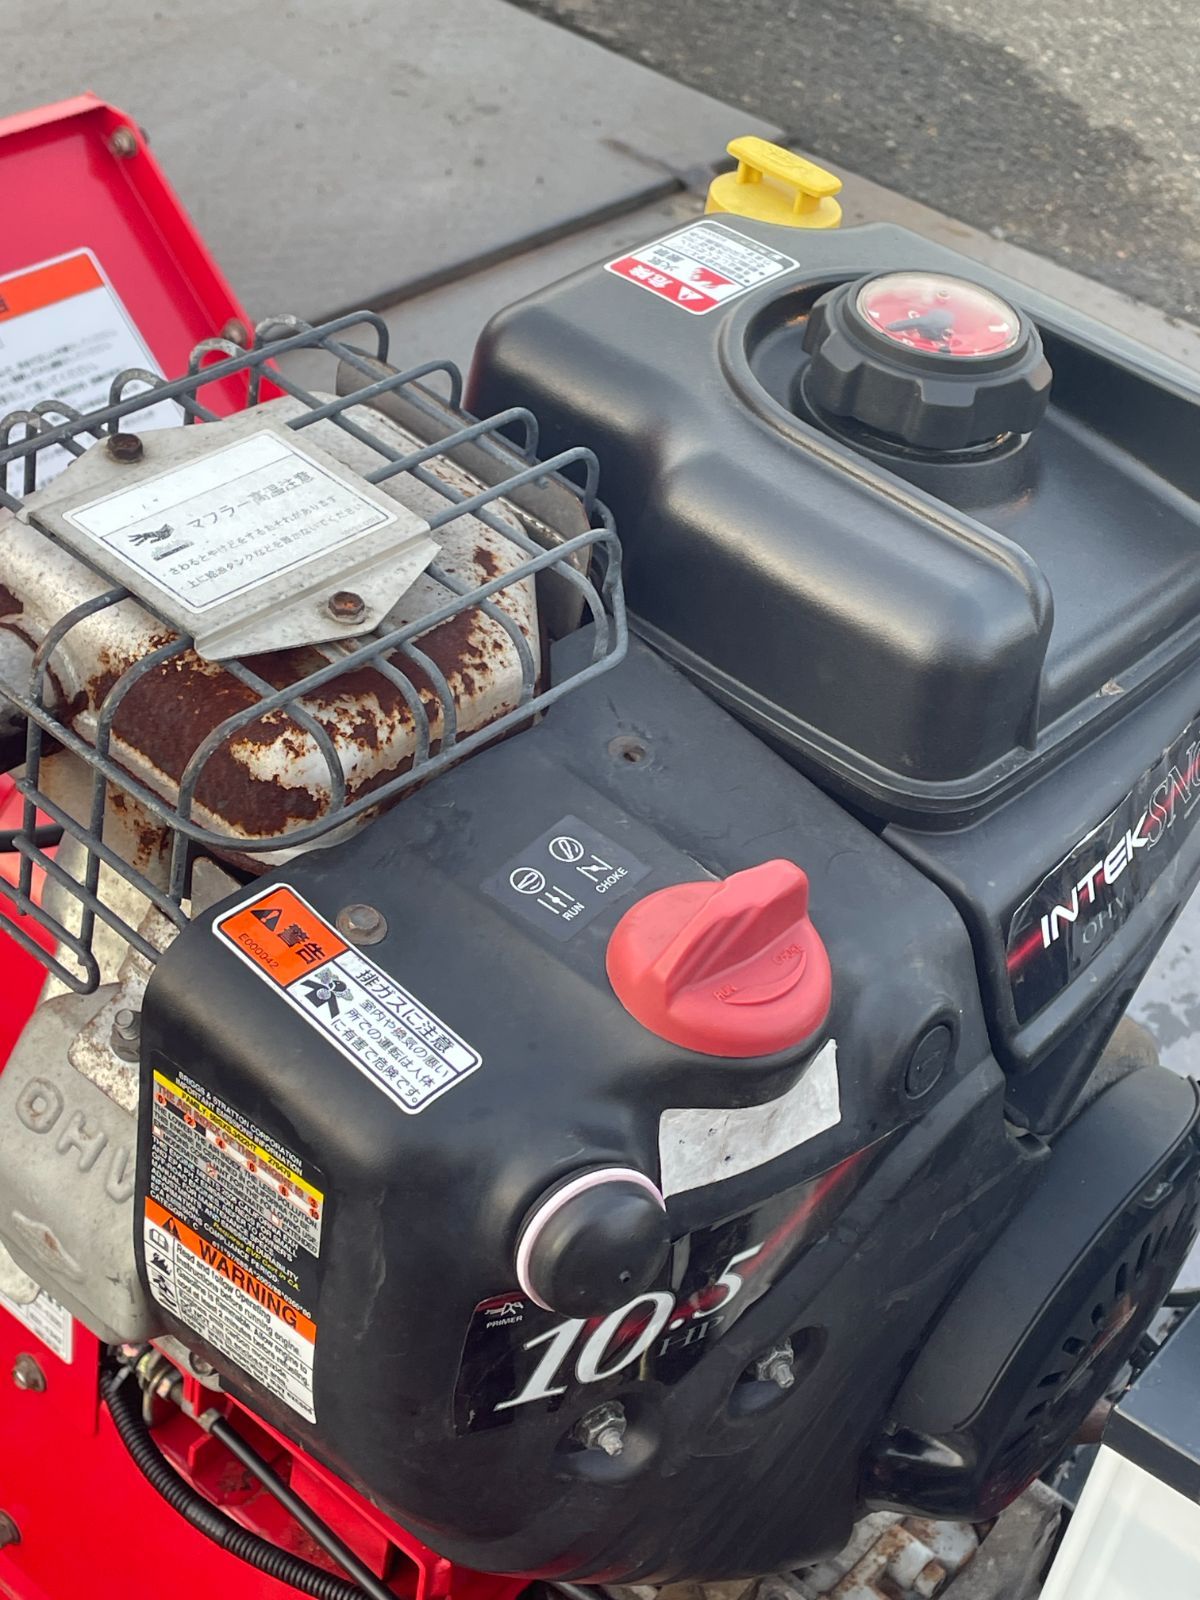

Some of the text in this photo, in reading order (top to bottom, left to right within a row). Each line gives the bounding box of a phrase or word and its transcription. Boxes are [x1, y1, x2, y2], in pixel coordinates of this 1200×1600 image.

[182, 469, 317, 532] マフラー高温注意
[561, 902, 585, 921] RUN
[595, 866, 629, 893] CHOKE
[1040, 811, 1148, 948] INTEK
[1082, 888, 1126, 944] OHV
[274, 921, 330, 967] 警告
[354, 967, 456, 1054] 排ガスに注意
[713, 983, 737, 1000] RUN
[328, 1017, 426, 1105] に有害で危険です。
[343, 1006, 437, 1090] 所での運転は人体
[358, 997, 451, 1079] 室内や換気の悪い
[15, 1078, 135, 1204] OHV
[154, 1102, 166, 1117] THE
[168, 1113, 192, 1136] LOWER
[193, 1131, 206, 1147] THE
[208, 1142, 219, 1157] AIR
[244, 1169, 257, 1184] THE
[258, 1180, 276, 1198] LESS
[175, 1077, 302, 1176] IMPORTANT EMISSIONS INFORMATION
[178, 1070, 301, 1167] BRIGGS & STRATTON CORPORATION
[151, 1158, 180, 1186] MANUAL
[181, 1181, 196, 1198] FOR
[197, 1193, 248, 1238] MAINTENANCE
[152, 1135, 167, 1152] THIS
[169, 1147, 195, 1173] ENGINE
[196, 1168, 220, 1192] MEETS
[238, 1200, 281, 1238] CALIFORNIA
[282, 1233, 298, 1251] EXH
[152, 1143, 167, 1159] AND
[168, 1155, 182, 1171] EPA
[183, 1166, 193, 1180] PH
[194, 1175, 199, 1184] 2
[200, 1179, 233, 1210] EMISSION
[256, 1221, 271, 1238] FOR
[272, 1234, 297, 1258] SMALL
[153, 1110, 309, 1231] THIS ENGINE IS CERTIFIED IN CALIFORNIA TO BE
[153, 1117, 188, 1149] EMISSIONS
[190, 1145, 228, 1179] COMPLIANT
[229, 1174, 243, 1190] FOR
[245, 1186, 257, 1201] THE
[259, 1197, 300, 1233] FOLLOWING
[163, 1132, 317, 1254] MODERATE INTERMEDIATE EXTENDED
[150, 1181, 164, 1198] EPA
[165, 1193, 202, 1226] EMISSIONS
[203, 1222, 249, 1262] COMPLIANCE
[192, 1221, 198, 1231] C
[204, 1207, 220, 1224] AND
[221, 1219, 255, 1250] EMISSION
[255, 1245, 298, 1283] DURABILITY
[222, 1204, 246, 1227] REFER
[247, 1223, 257, 1236] TO
[176, 1254, 218, 1293] Instructions
[220, 1288, 243, 1312] before
[244, 1307, 272, 1337] running
[177, 1242, 270, 1324] Read and follow Operating
[199, 1239, 297, 1330] WARNING
[486, 1314, 524, 1329] PRIMER
[218, 1309, 222, 1318] 2
[253, 1336, 275, 1360] before
[254, 1327, 272, 1348] Allow
[274, 1342, 298, 1369] engine
[299, 1362, 307, 1375] to
[493, 1242, 765, 1411] 10.5
[658, 1314, 724, 1357] HP
